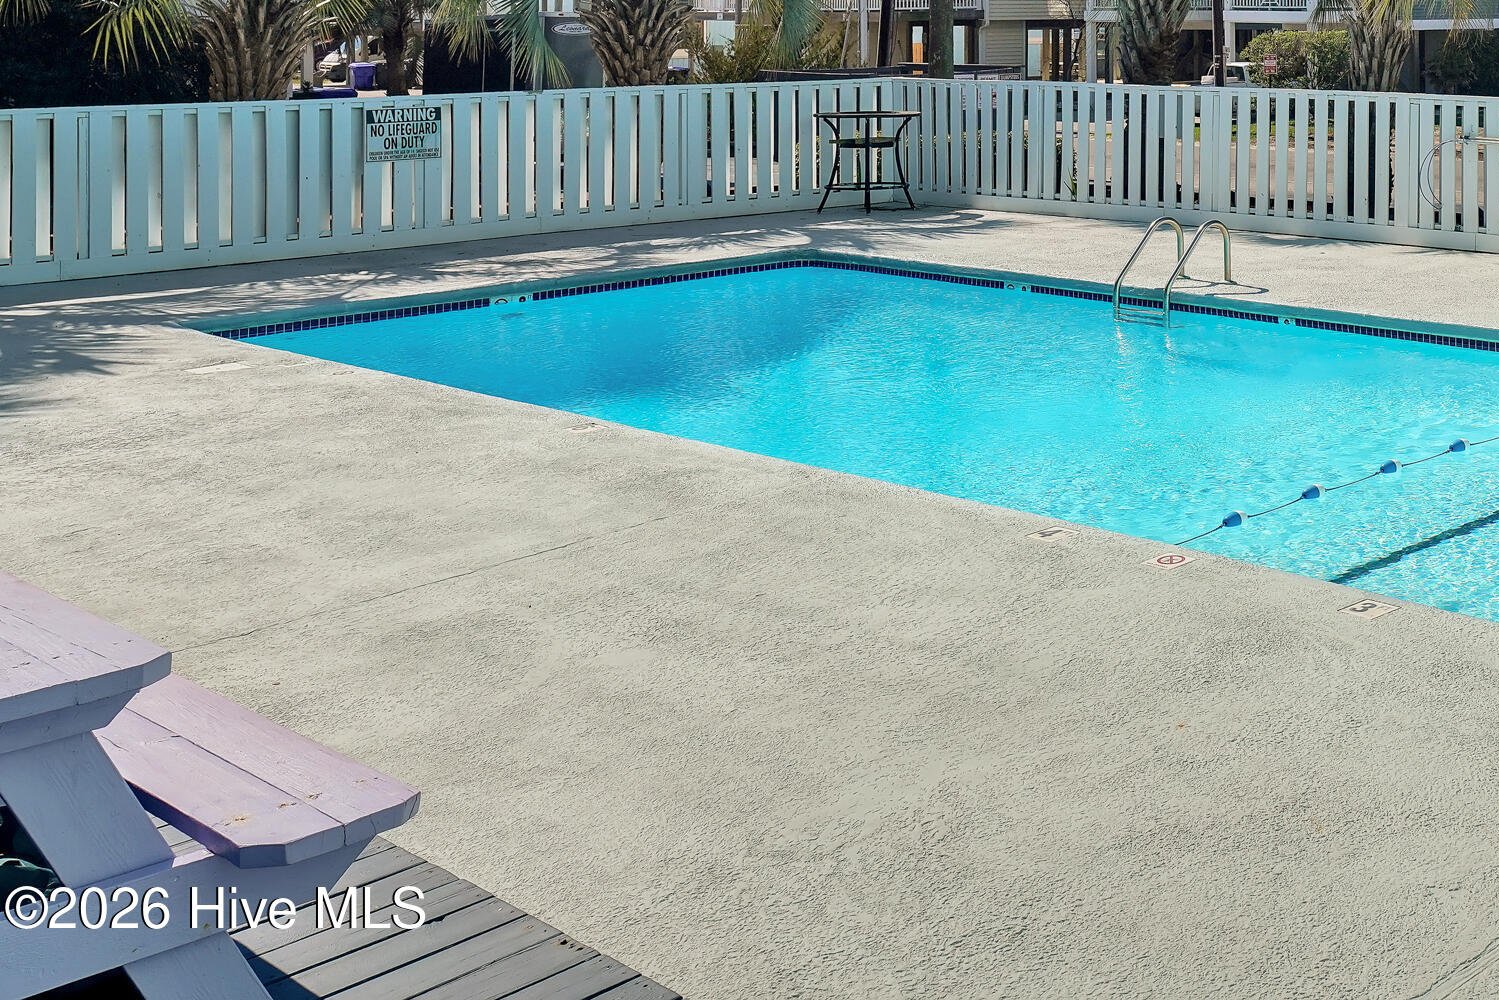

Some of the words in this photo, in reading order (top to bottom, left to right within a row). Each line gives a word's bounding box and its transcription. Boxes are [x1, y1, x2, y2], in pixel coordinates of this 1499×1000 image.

[372, 107, 436, 123] WARNING
[370, 124, 385, 137] NO
[388, 122, 438, 136] LIFEGUARD
[383, 137, 398, 150] ON
[401, 135, 425, 149] DUTY
